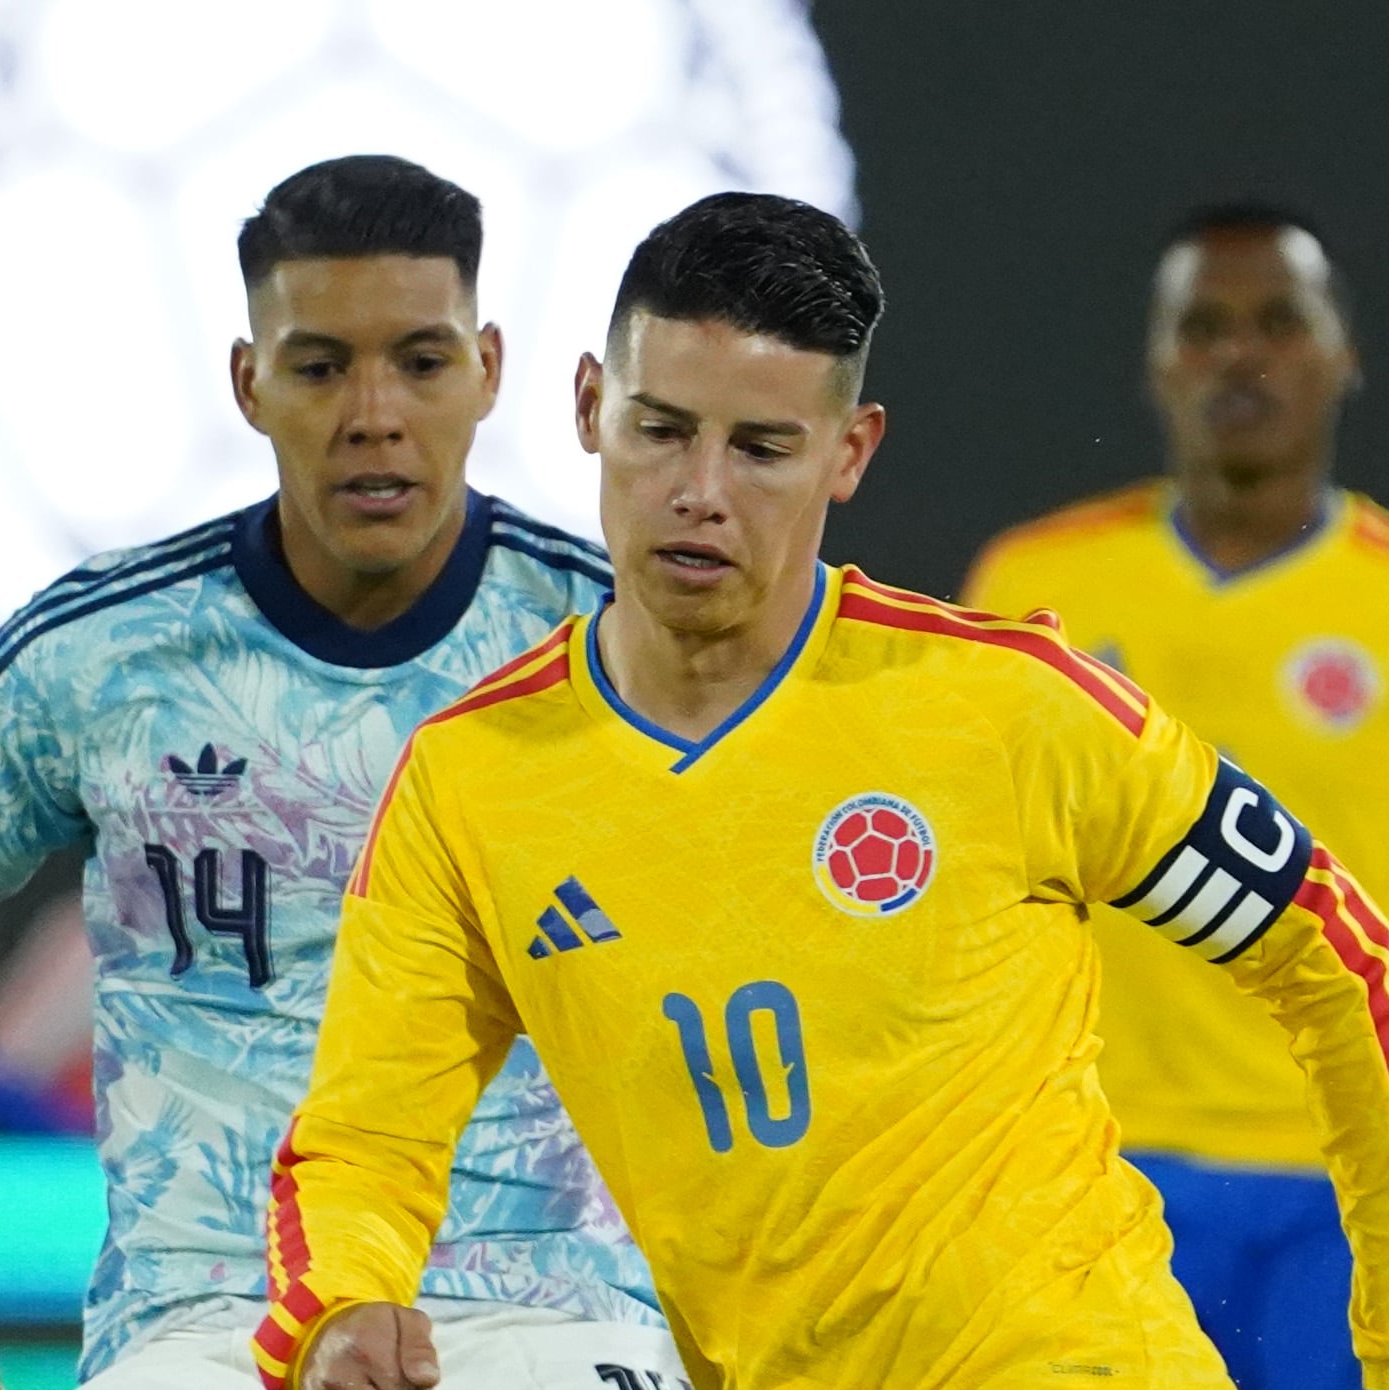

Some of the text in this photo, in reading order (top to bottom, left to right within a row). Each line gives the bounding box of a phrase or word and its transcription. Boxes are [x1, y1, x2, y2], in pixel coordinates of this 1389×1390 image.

[1220, 787, 1296, 873] C
[144, 843, 272, 988] 14
[662, 979, 812, 1153] 10
